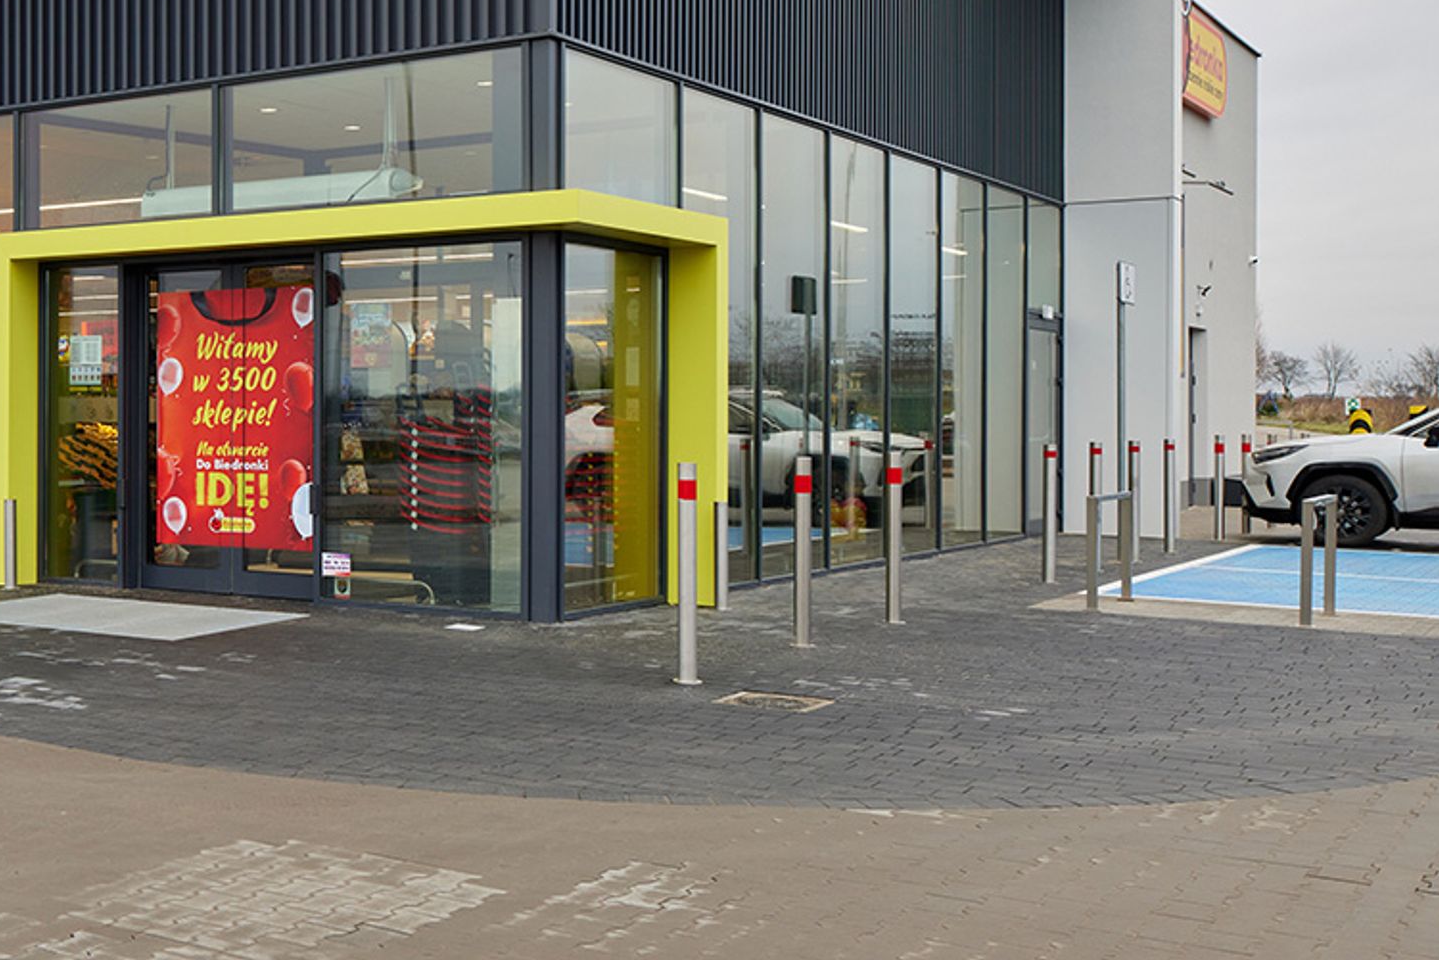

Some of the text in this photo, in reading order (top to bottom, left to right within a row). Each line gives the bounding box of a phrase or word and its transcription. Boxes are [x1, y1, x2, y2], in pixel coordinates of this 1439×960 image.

[195, 331, 278, 362] Witamy
[192, 367, 277, 392] w 3500
[192, 397, 278, 432] sklepie!
[195, 457, 269, 471] Do Biedronki
[195, 471, 270, 517] IDĘ!
